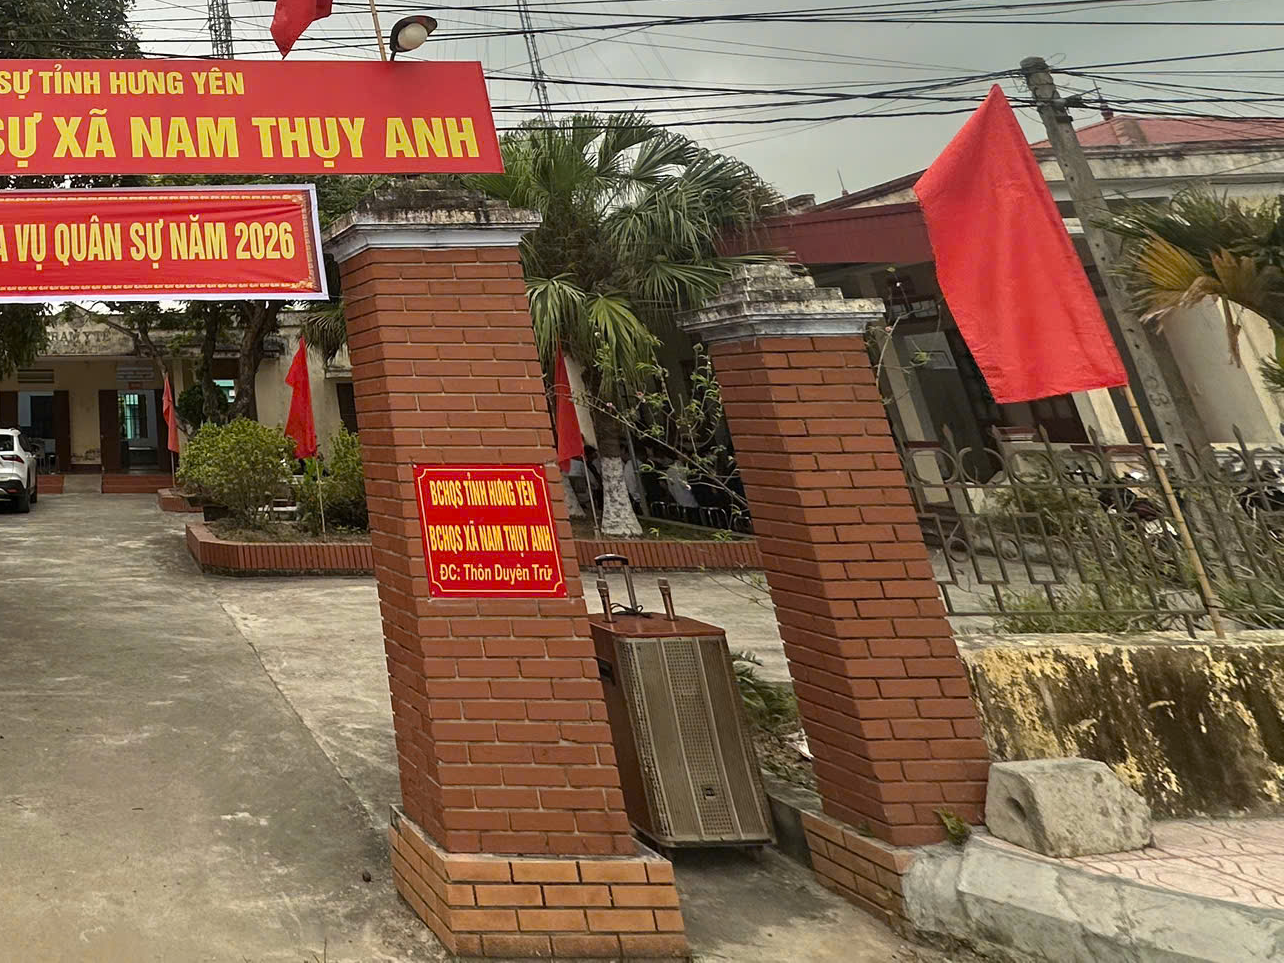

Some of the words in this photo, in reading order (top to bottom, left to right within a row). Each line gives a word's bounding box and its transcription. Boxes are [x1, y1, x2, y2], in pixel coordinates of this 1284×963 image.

[38, 63, 101, 94] TỈNH
[109, 69, 185, 95] HƯNG
[191, 67, 245, 95] YÊN
[52, 109, 117, 159] XÃ
[129, 116, 240, 158] NAM
[251, 116, 366, 168] THỤY
[384, 116, 480, 158] ANH
[15, 223, 47, 271] VỤ
[54, 215, 123, 266] QUÂN
[129, 219, 165, 270] SỰ
[169, 213, 229, 261] NĂM
[234, 221, 296, 260] 2026
[429, 480, 464, 509] BCHQS
[463, 472, 489, 506] TỈNH
[487, 478, 517, 506] HƯNG
[515, 475, 538, 506] YÊN
[428, 525, 464, 554] BCHQS
[463, 520, 480, 551] XÃ
[479, 525, 504, 551] NAM
[503, 525, 529, 557] THỤY
[530, 525, 553, 551] ANH
[440, 564, 461, 581] ĐC:
[463, 563, 492, 581] Thôn
[494, 563, 530, 585] Duyên
[531, 564, 553, 581] Trữ
